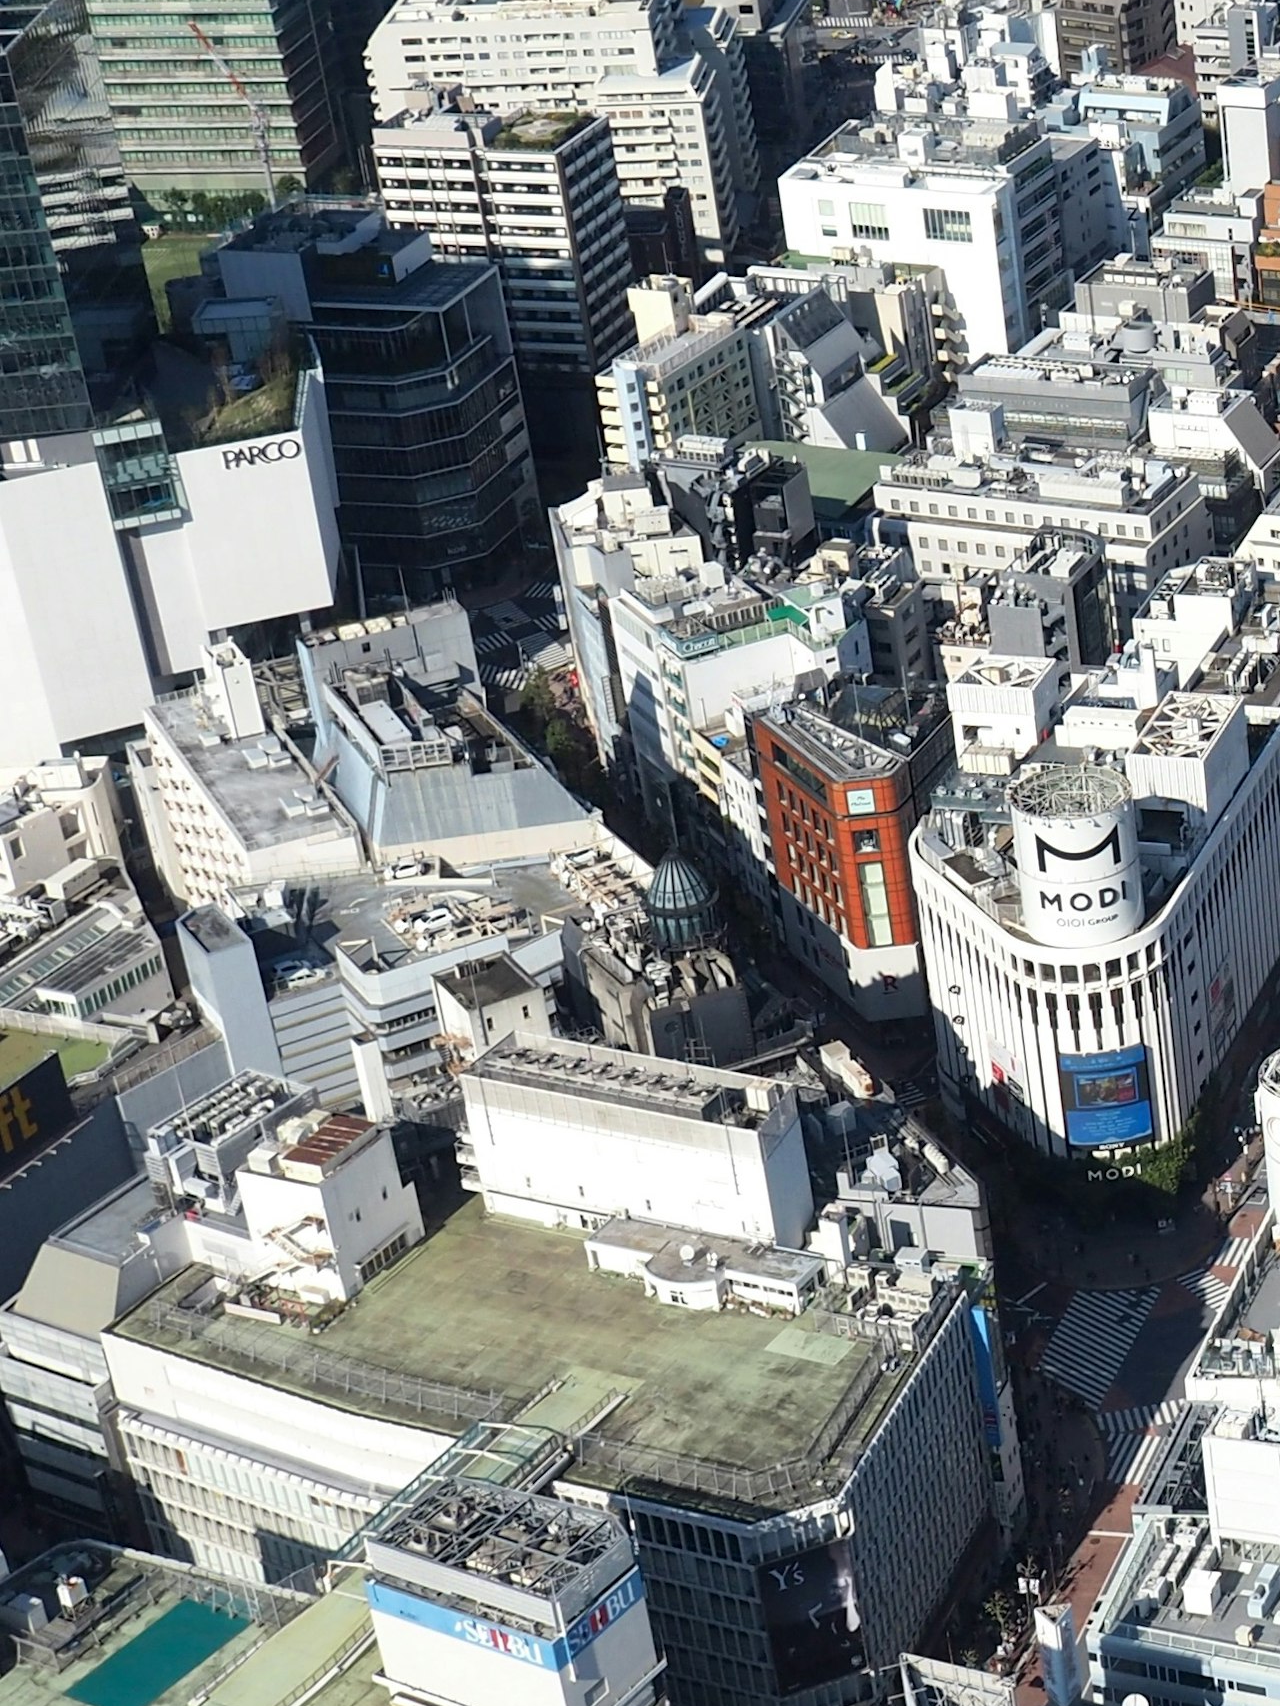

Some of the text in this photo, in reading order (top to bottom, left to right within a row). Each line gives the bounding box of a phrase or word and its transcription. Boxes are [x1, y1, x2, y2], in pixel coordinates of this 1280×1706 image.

[222, 439, 302, 470] PARCO
[1040, 880, 1127, 913] MODI
[1100, 1141, 1126, 1151] SONY
[1088, 1162, 1142, 1182] MODI
[770, 1564, 805, 1591] Y's
[566, 1587, 635, 1659] SEIBU
[465, 1618, 543, 1664] SEIBU
